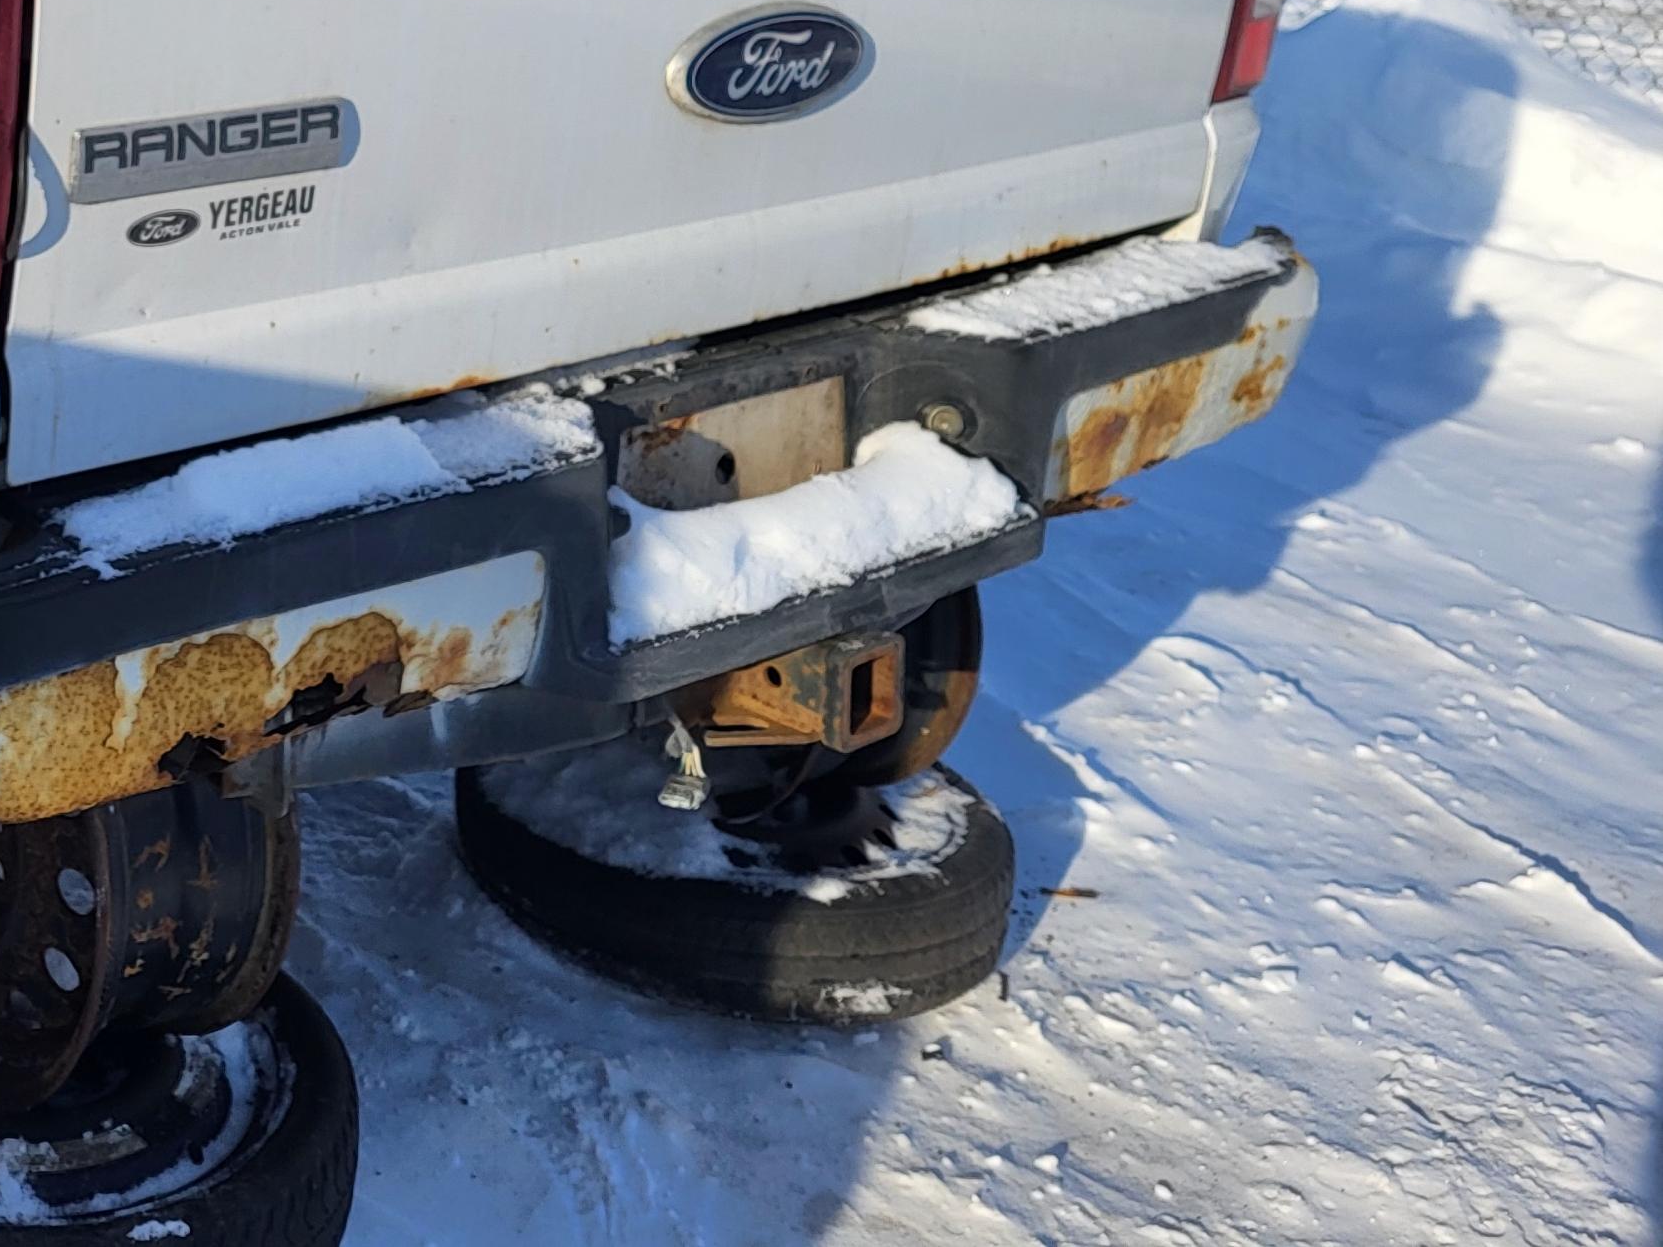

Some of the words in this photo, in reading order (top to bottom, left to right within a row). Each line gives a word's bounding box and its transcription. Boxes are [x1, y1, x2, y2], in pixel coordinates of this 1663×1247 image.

[726, 28, 837, 101] Ford
[83, 104, 340, 175] RANGER
[139, 215, 187, 242] Ford
[209, 184, 316, 230] YERGEAU
[219, 224, 265, 241] ACTON
[268, 218, 301, 233] VALE
